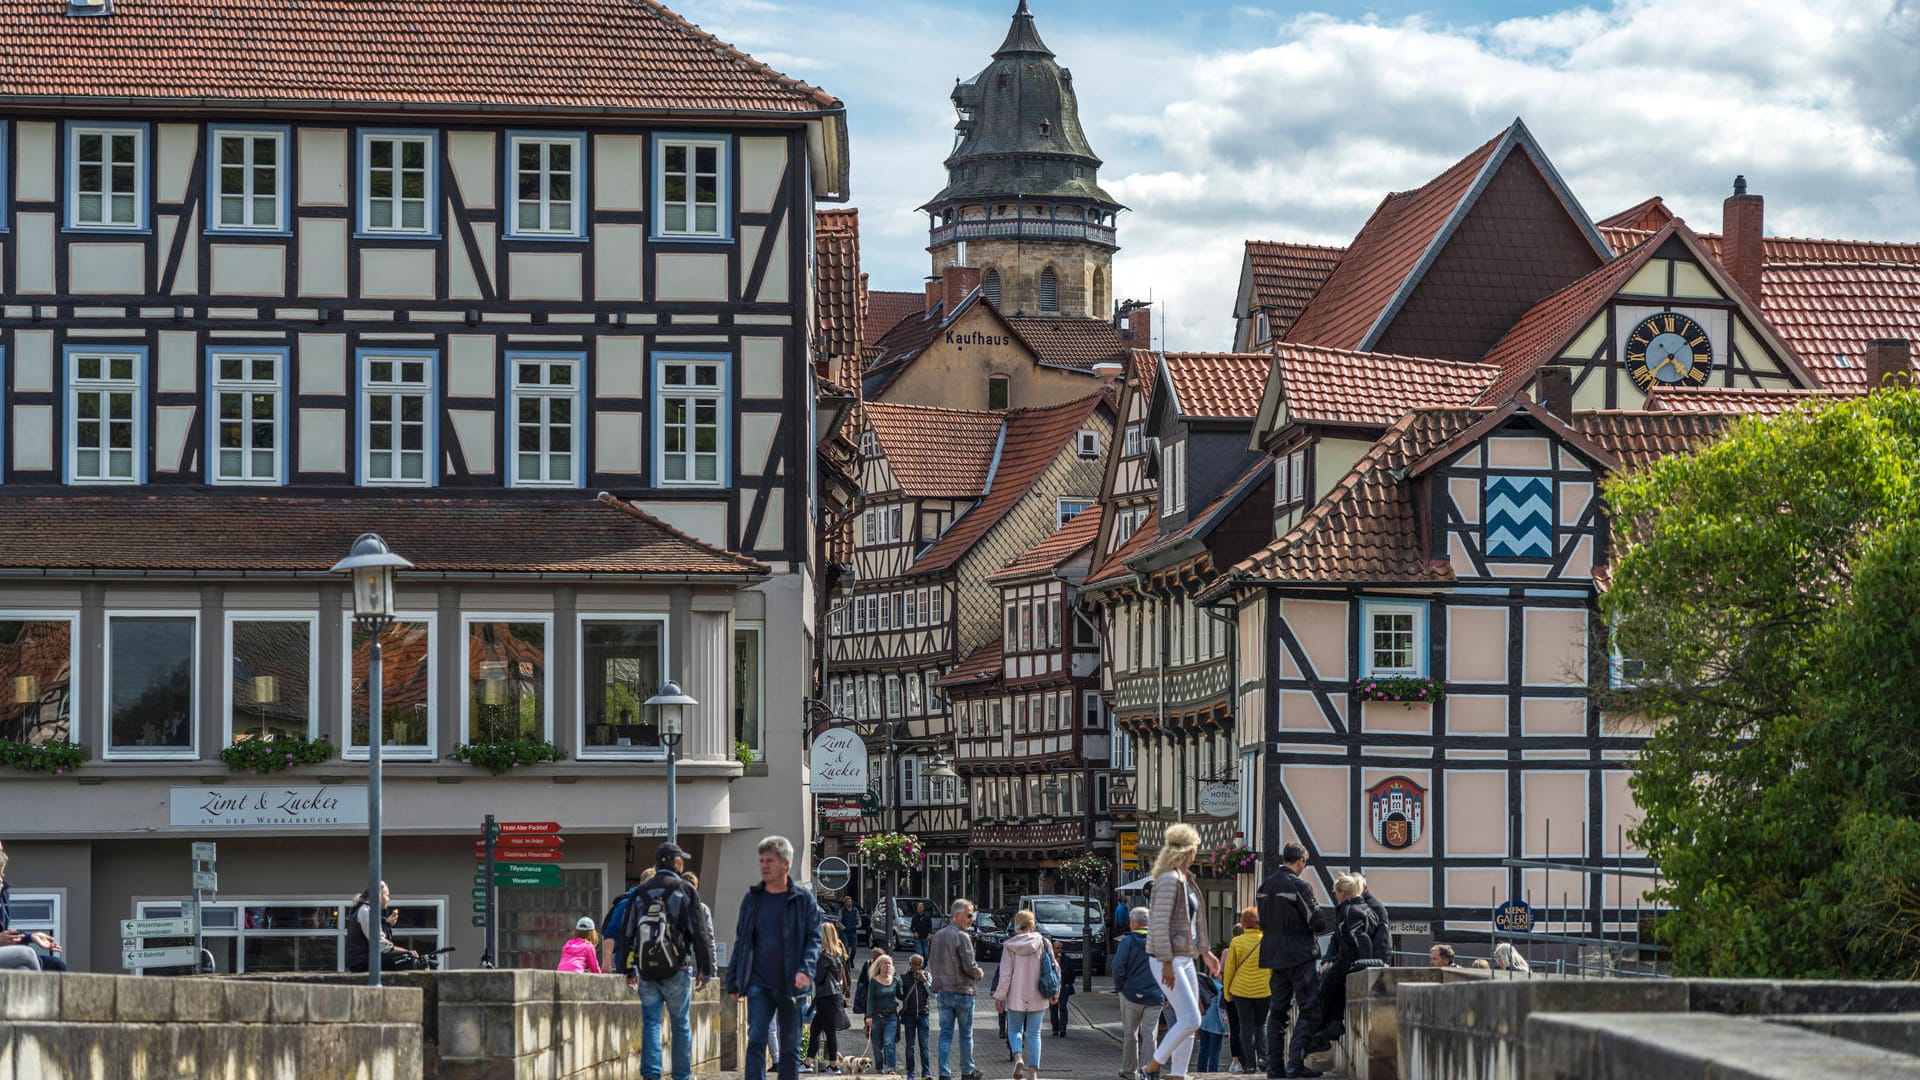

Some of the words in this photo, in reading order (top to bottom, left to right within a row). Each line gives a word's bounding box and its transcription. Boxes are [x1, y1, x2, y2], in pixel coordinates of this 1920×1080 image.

[946, 330, 1009, 345] Kaufhaus
[819, 735, 853, 752] Zimt
[834, 751, 843, 763] &
[819, 760, 861, 780] Zucker
[200, 791, 248, 815] Zimt
[254, 791, 268, 810] &
[277, 786, 339, 815] Zucker
[637, 825, 669, 835] Dielengrabe
[1504, 906, 1526, 914] KEINE
[1401, 923, 1428, 933] Schlagd
